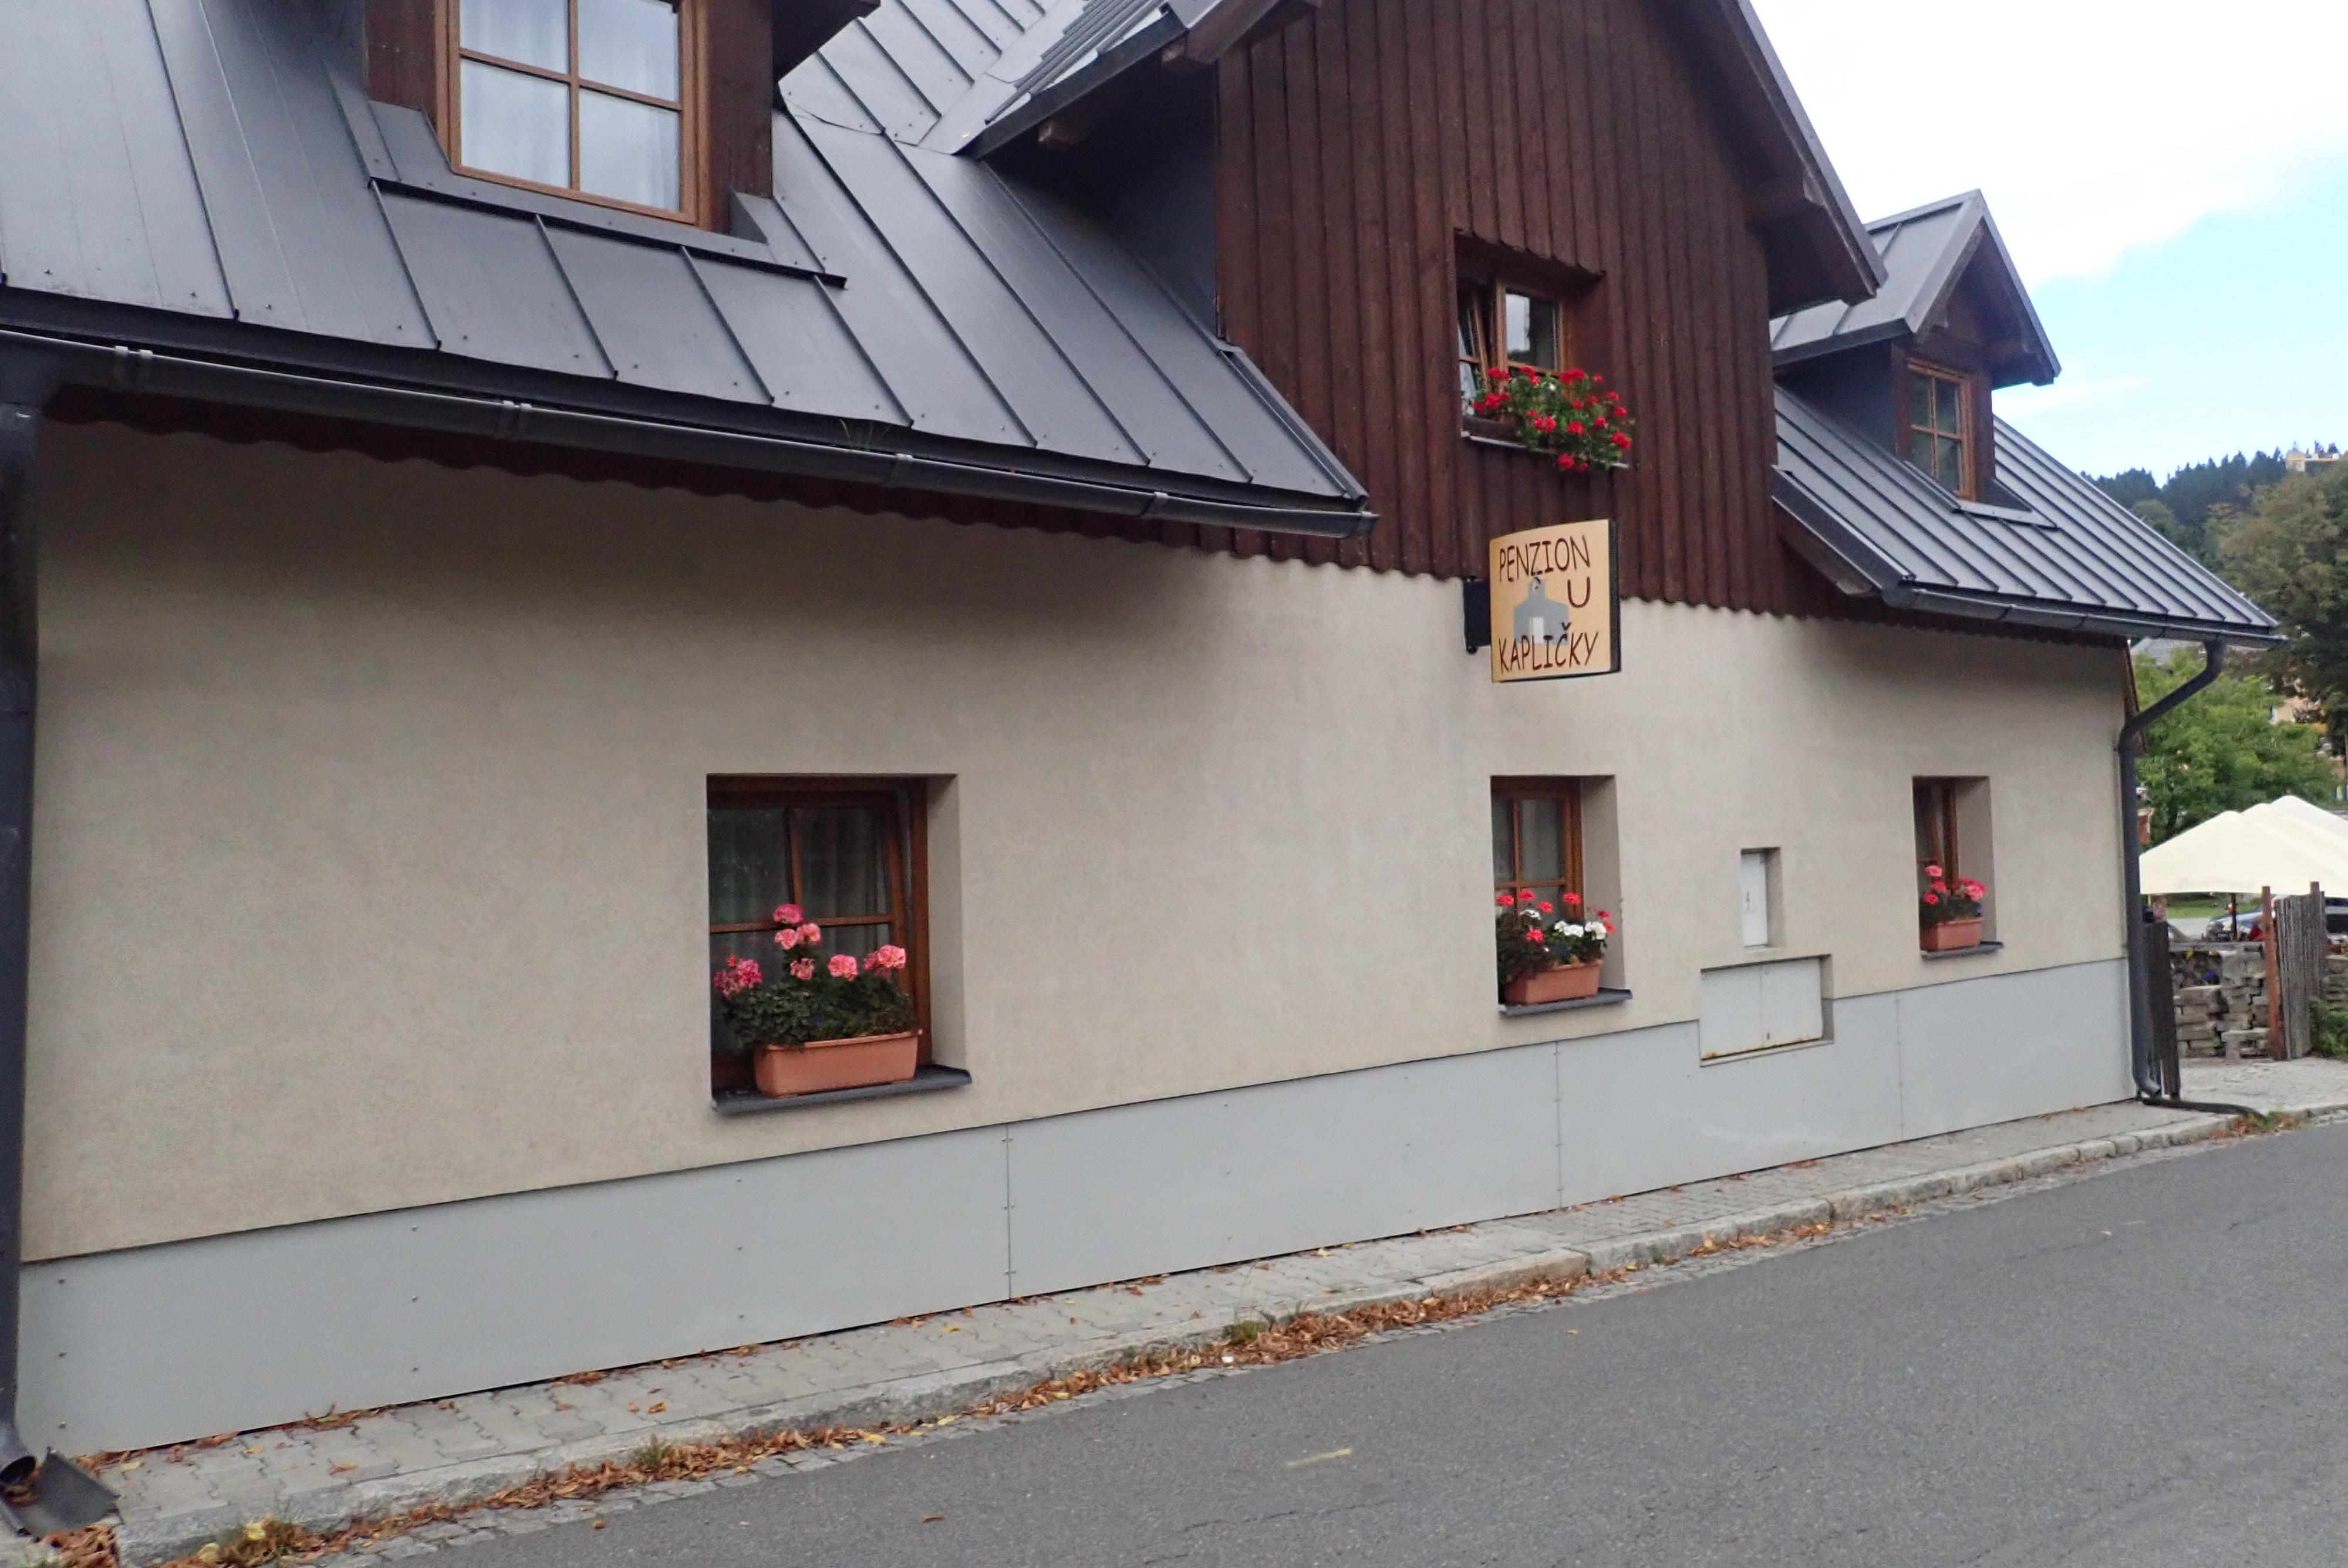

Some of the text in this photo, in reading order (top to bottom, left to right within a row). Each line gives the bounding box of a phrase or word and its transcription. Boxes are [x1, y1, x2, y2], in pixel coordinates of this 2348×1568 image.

[1499, 535, 1591, 583] PENZION
[1567, 576, 1591, 609] U
[1498, 621, 1599, 675] KAPLIČKY
